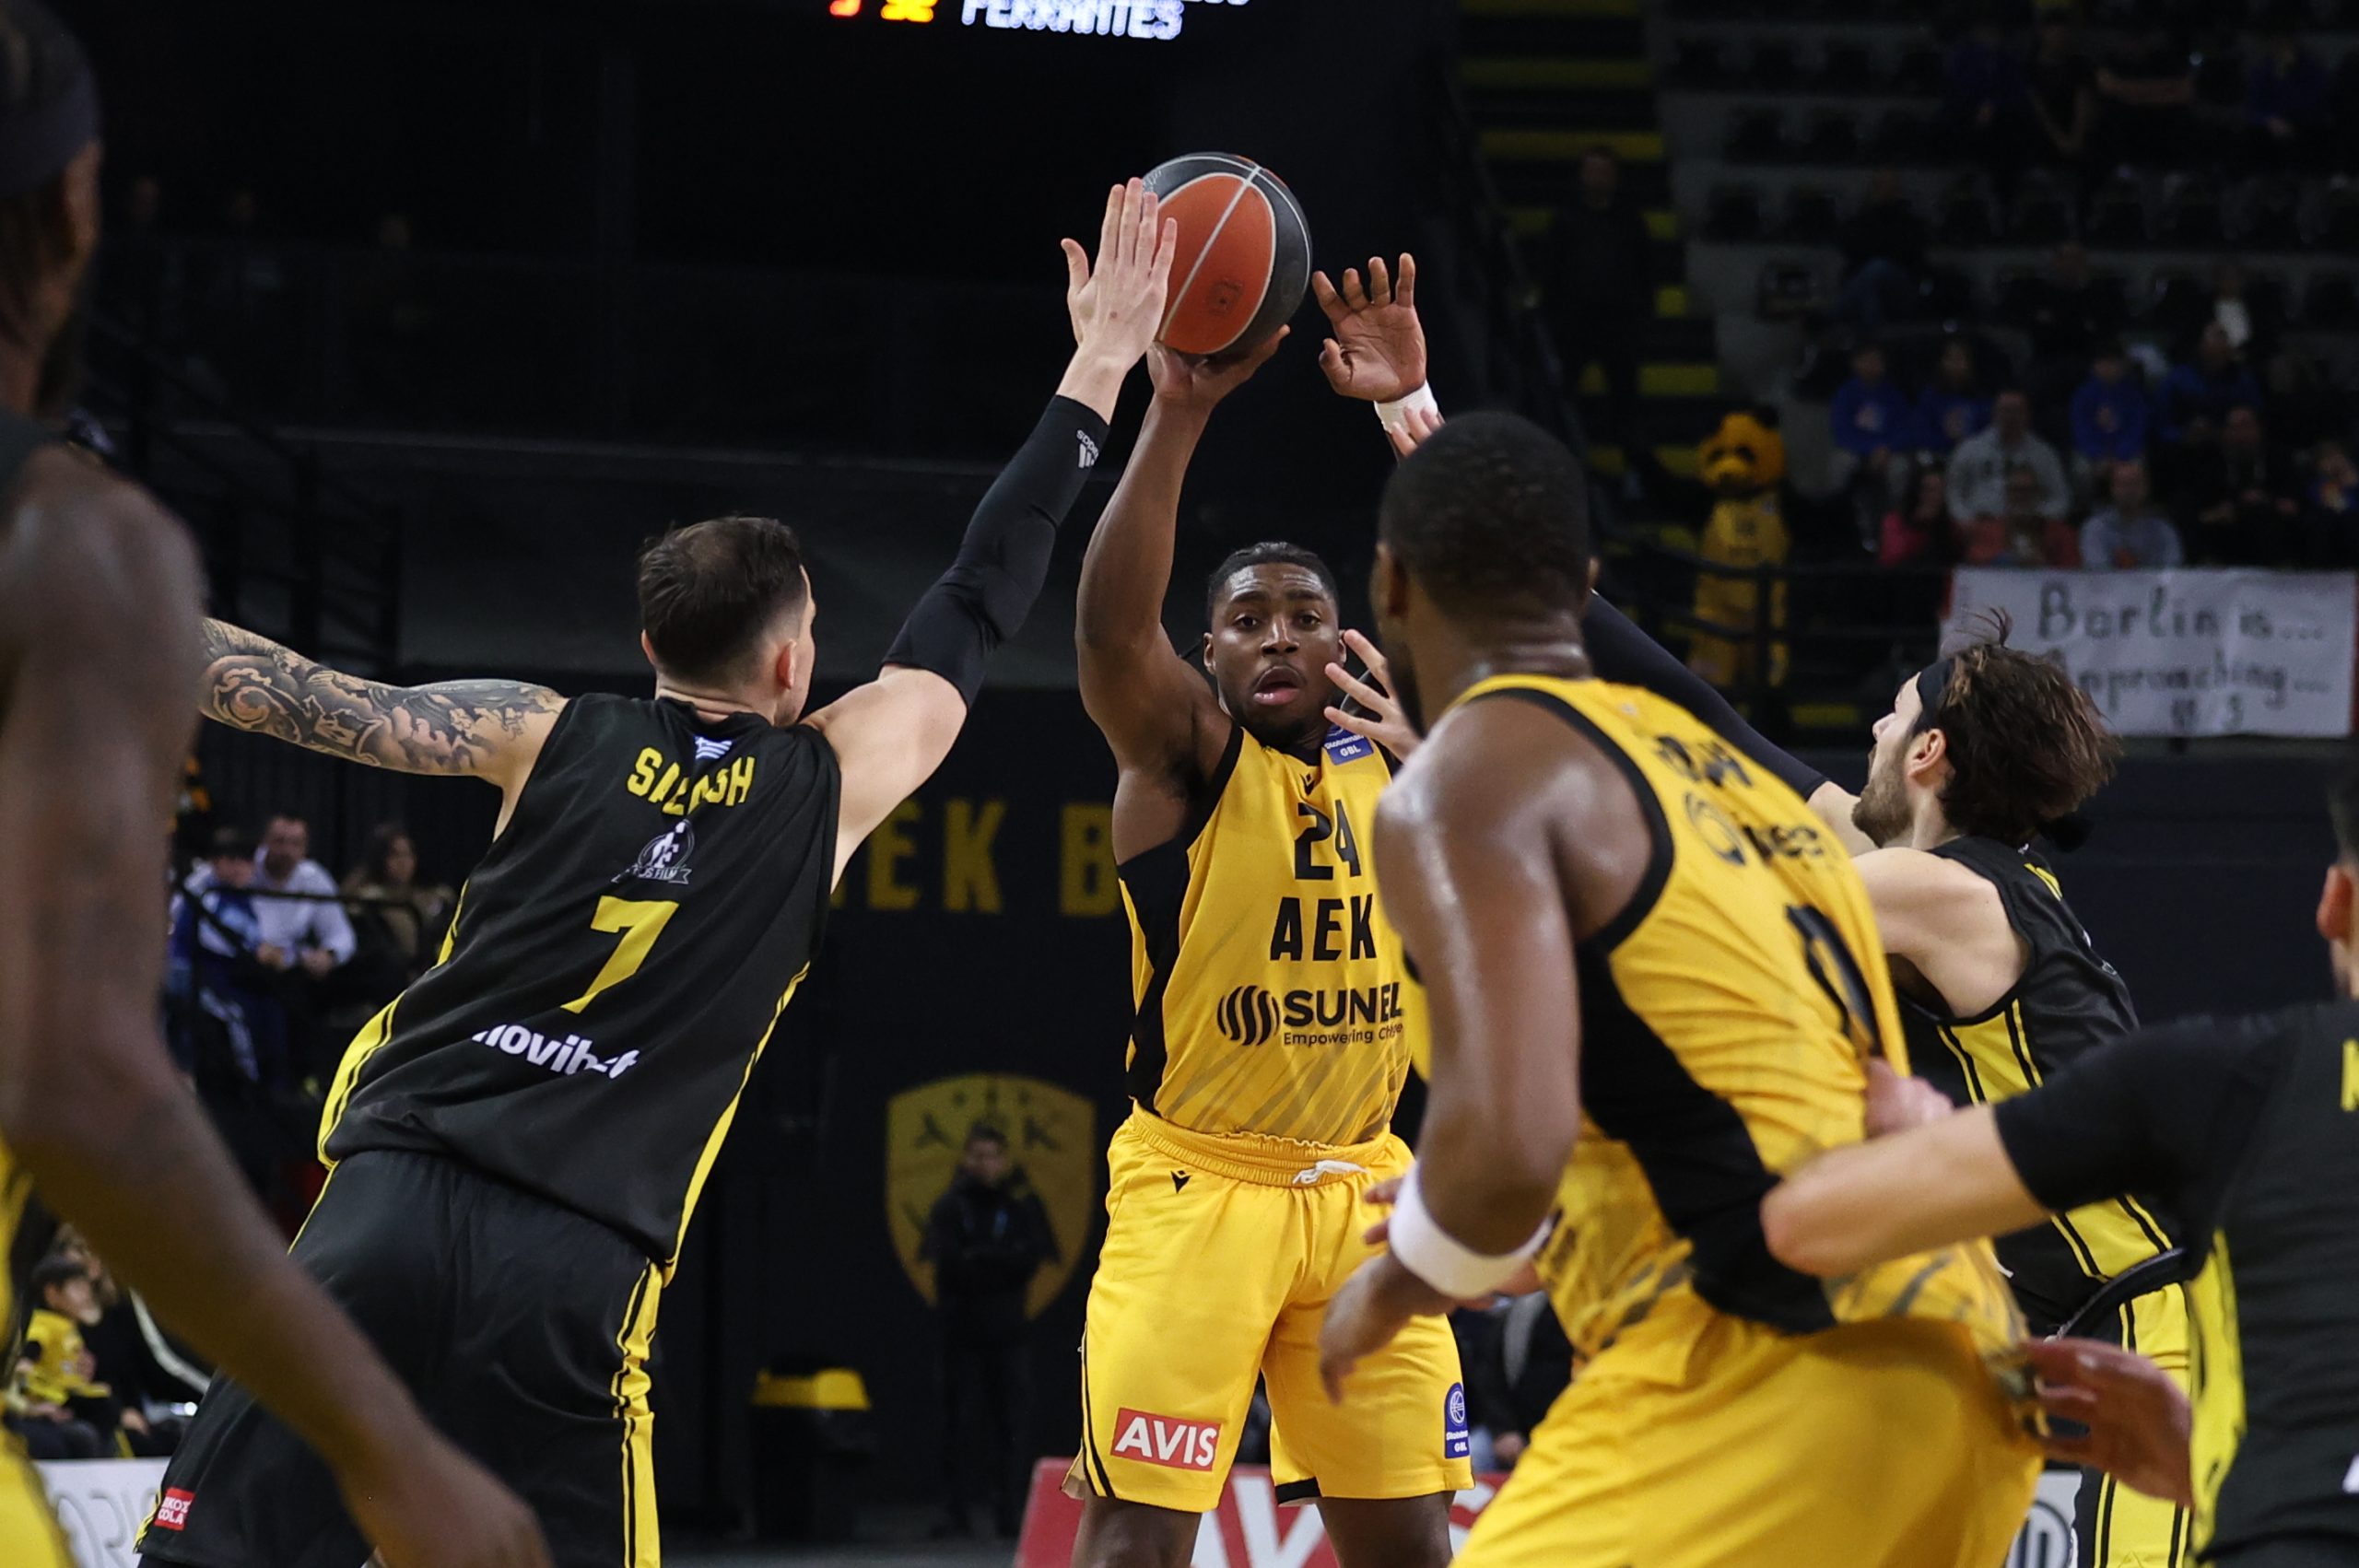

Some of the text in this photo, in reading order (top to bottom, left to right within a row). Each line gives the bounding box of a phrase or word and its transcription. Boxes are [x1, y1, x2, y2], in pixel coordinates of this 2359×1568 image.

[1340, 744, 1361, 756] GBL
[830, 798, 1007, 914] EK
[1295, 799, 1362, 880] 24
[559, 895, 680, 1014] 7
[1270, 894, 1377, 961] AEK
[1283, 981, 1404, 1027] SUNEL
[1114, 1415, 1218, 1468] AVIS
